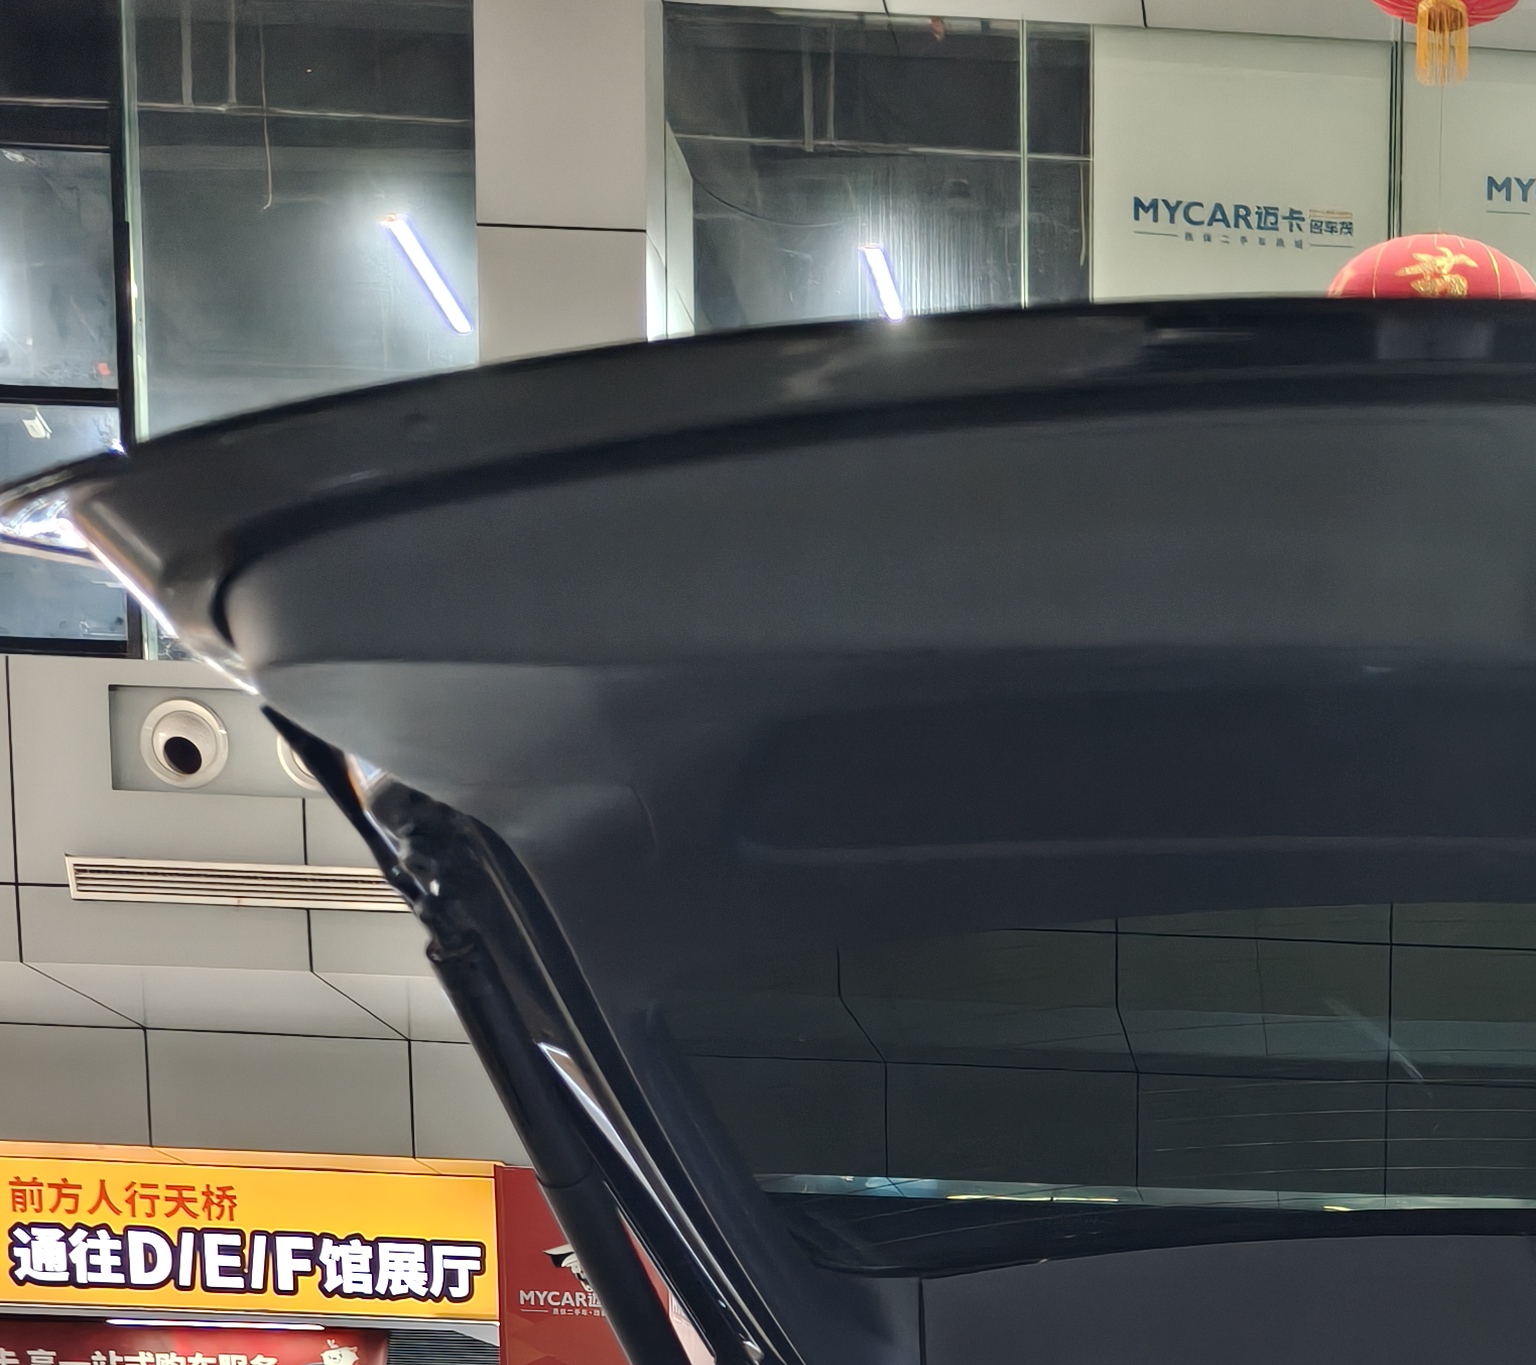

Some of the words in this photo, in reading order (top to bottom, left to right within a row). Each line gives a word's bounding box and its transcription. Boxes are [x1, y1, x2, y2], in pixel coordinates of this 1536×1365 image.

[8, 1175, 238, 1222] 前方人行天桥
[11, 1226, 484, 1300] 通往D/E/F馆展厅
